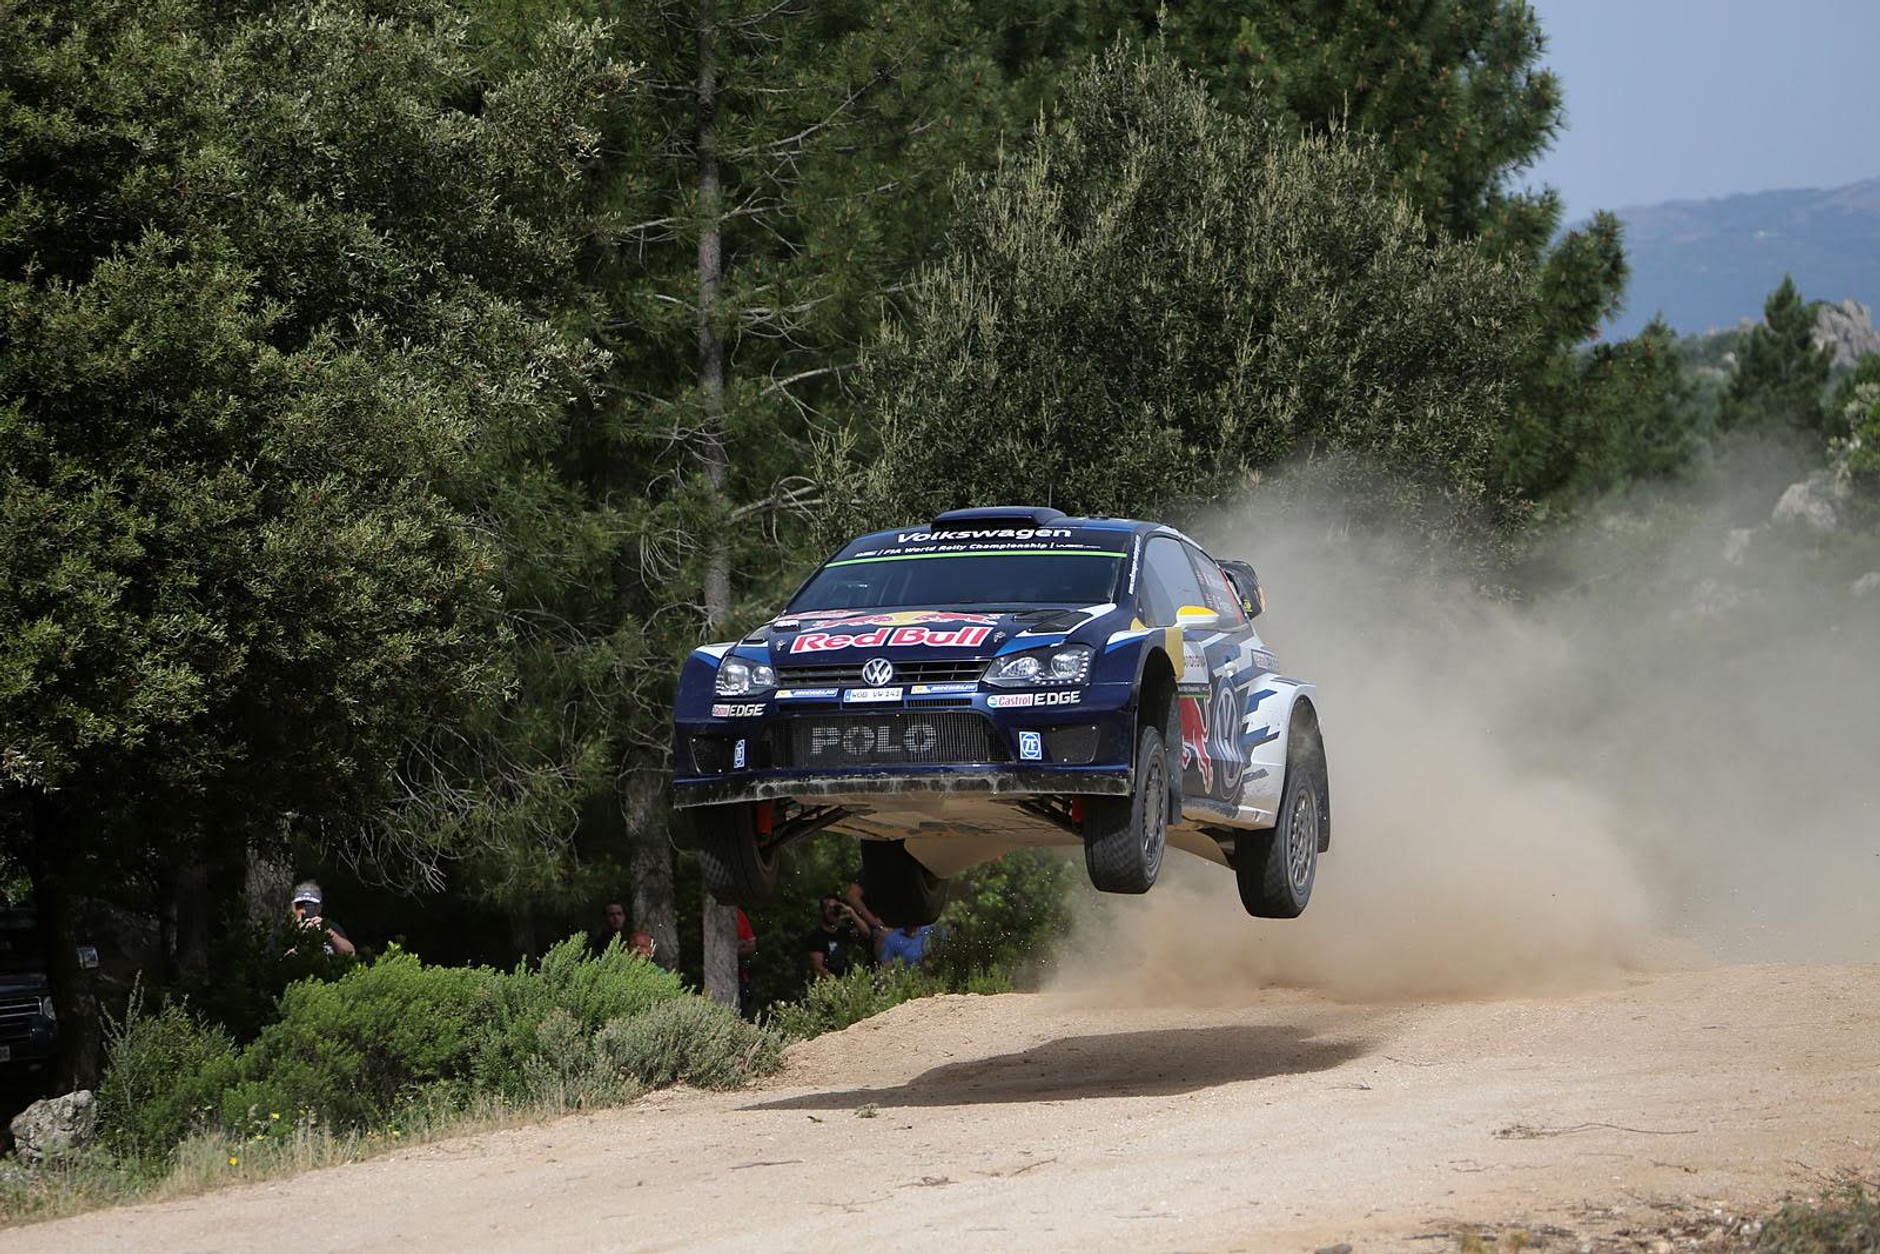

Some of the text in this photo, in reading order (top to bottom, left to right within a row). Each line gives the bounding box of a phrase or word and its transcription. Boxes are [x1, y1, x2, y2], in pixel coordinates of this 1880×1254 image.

[897, 528, 1072, 543] Volkswagen
[938, 544, 967, 552] Rally
[969, 542, 1047, 550] Championship
[791, 627, 992, 652] Red Bull
[998, 691, 1081, 706] Castrol EDGE
[729, 704, 766, 716] EDGE
[810, 725, 937, 755] POLO
